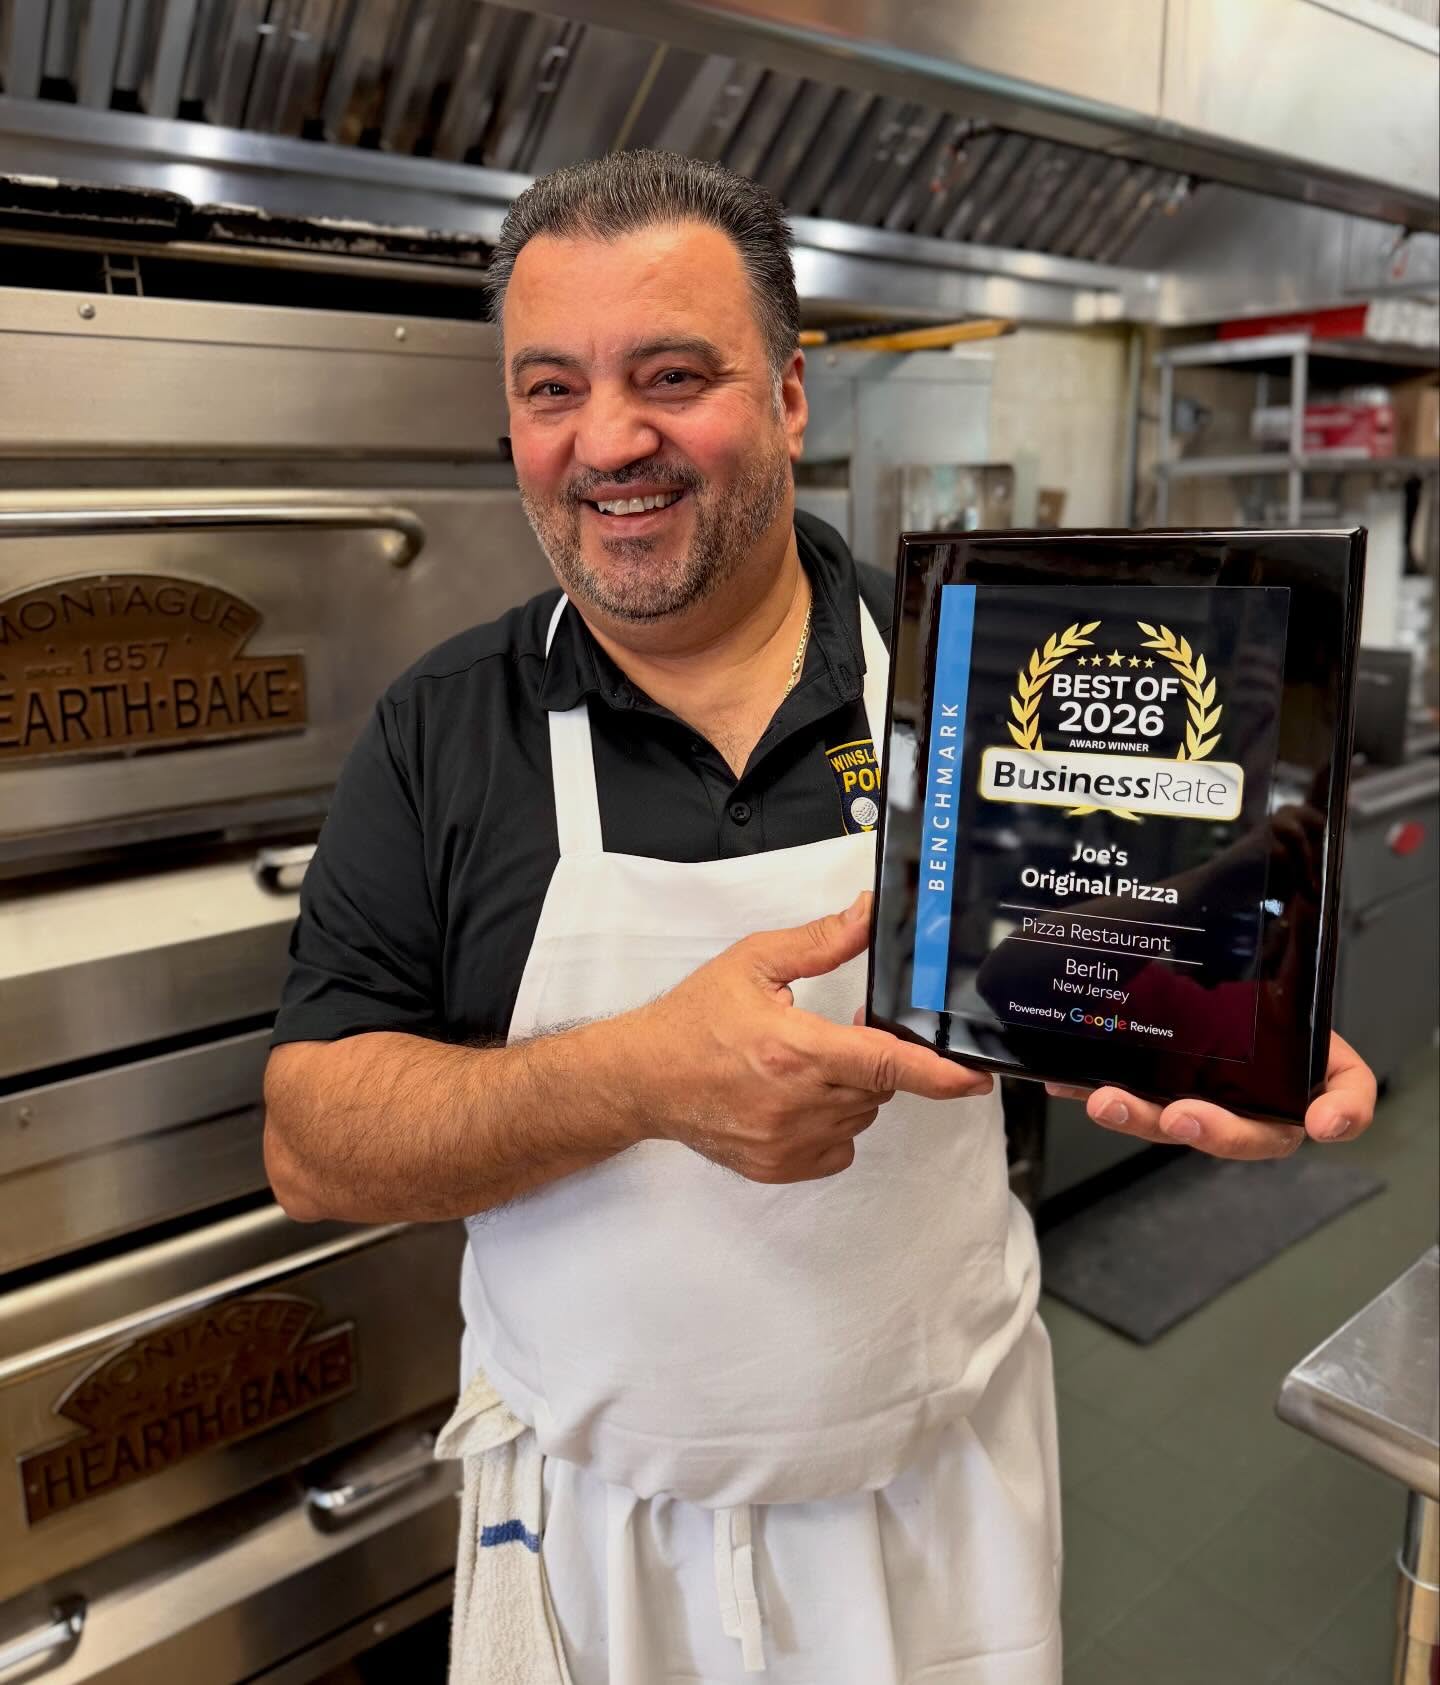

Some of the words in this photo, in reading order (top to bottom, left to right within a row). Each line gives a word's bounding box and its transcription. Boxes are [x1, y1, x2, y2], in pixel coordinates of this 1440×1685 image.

[82, 642, 169, 675] 1857
[1052, 673, 1134, 700] BEST
[1135, 676, 1179, 702] OF
[1058, 701, 1165, 737] 2026
[1069, 739, 1105, 751] AWARD
[1107, 741, 1149, 753] WINNER
[928, 703, 959, 892] BENCHMARK
[993, 761, 1227, 805] BusinessRate
[1072, 842, 1128, 866] Joe's
[1021, 868, 1111, 898] Original
[1116, 879, 1179, 904] Pizza
[1022, 917, 1065, 938] Pizza
[1070, 923, 1171, 952] Restaurant
[1066, 958, 1119, 982] Berlin
[1053, 978, 1083, 994] New
[1085, 984, 1130, 1004] Jersey
[1009, 1001, 1052, 1018] Powered
[1053, 1007, 1067, 1021] by
[1069, 1007, 1127, 1032] Google
[1130, 1021, 1174, 1038] Reviews
